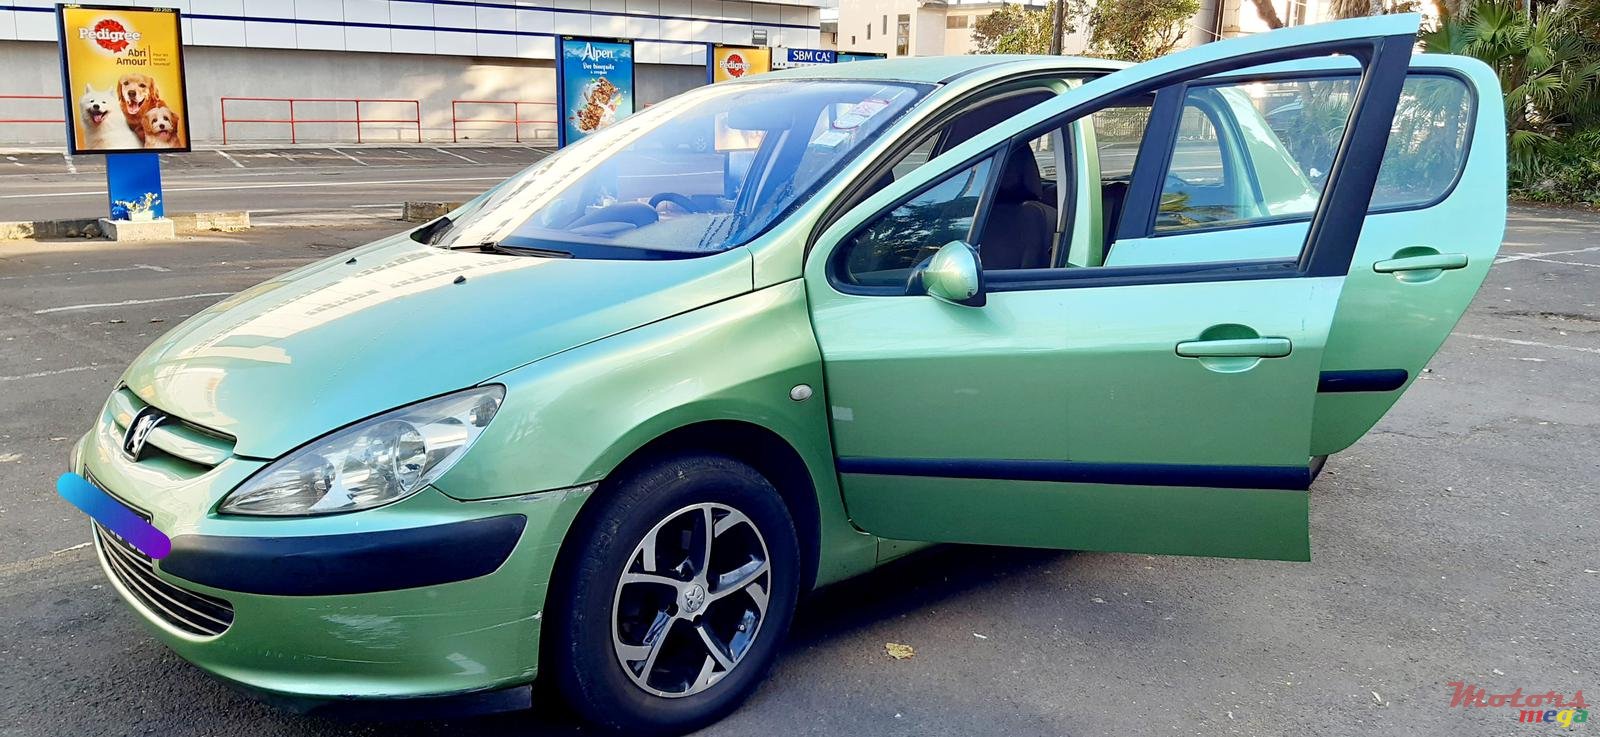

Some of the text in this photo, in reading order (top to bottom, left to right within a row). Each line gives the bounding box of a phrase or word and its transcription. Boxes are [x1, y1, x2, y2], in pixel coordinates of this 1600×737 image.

[79, 28, 140, 42] Pedigree
[128, 48, 146, 57] Abri
[581, 42, 613, 61] Alpen
[793, 50, 813, 61] SBM
[116, 57, 147, 66] Amour
